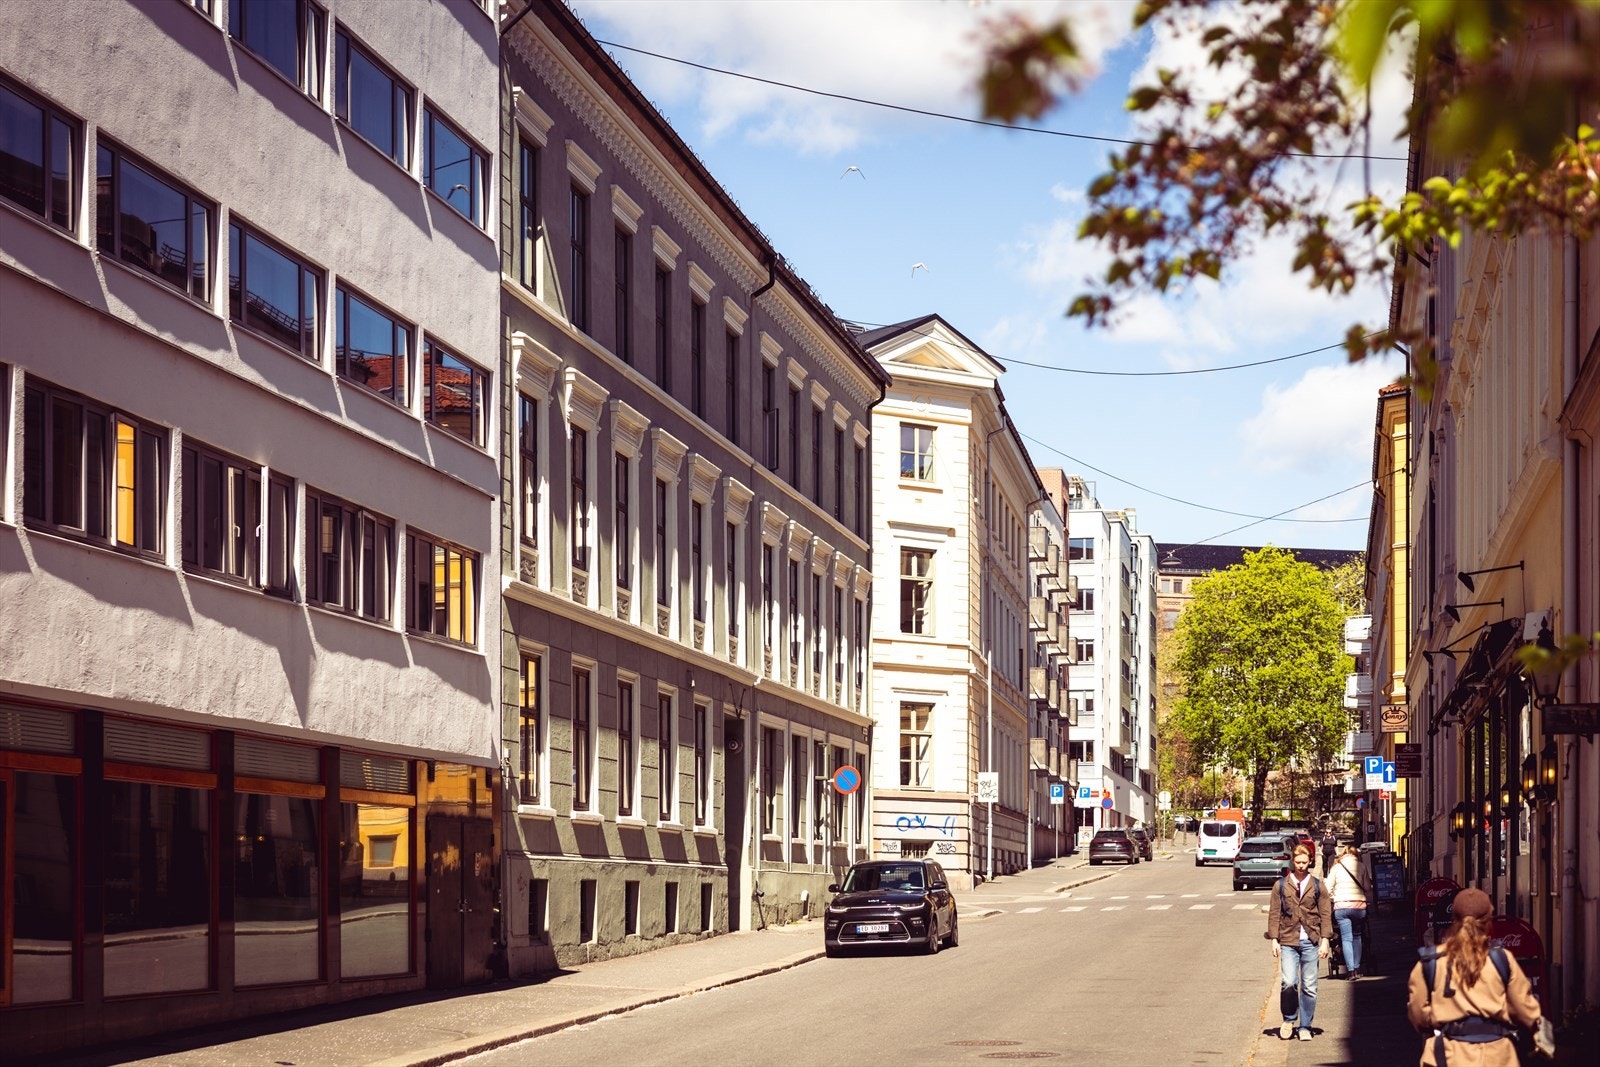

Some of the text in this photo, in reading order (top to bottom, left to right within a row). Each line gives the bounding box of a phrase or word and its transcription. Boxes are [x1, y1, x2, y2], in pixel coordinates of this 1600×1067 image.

[1369, 758, 1379, 772] P
[1053, 786, 1060, 797] P
[1081, 788, 1089, 797] P
